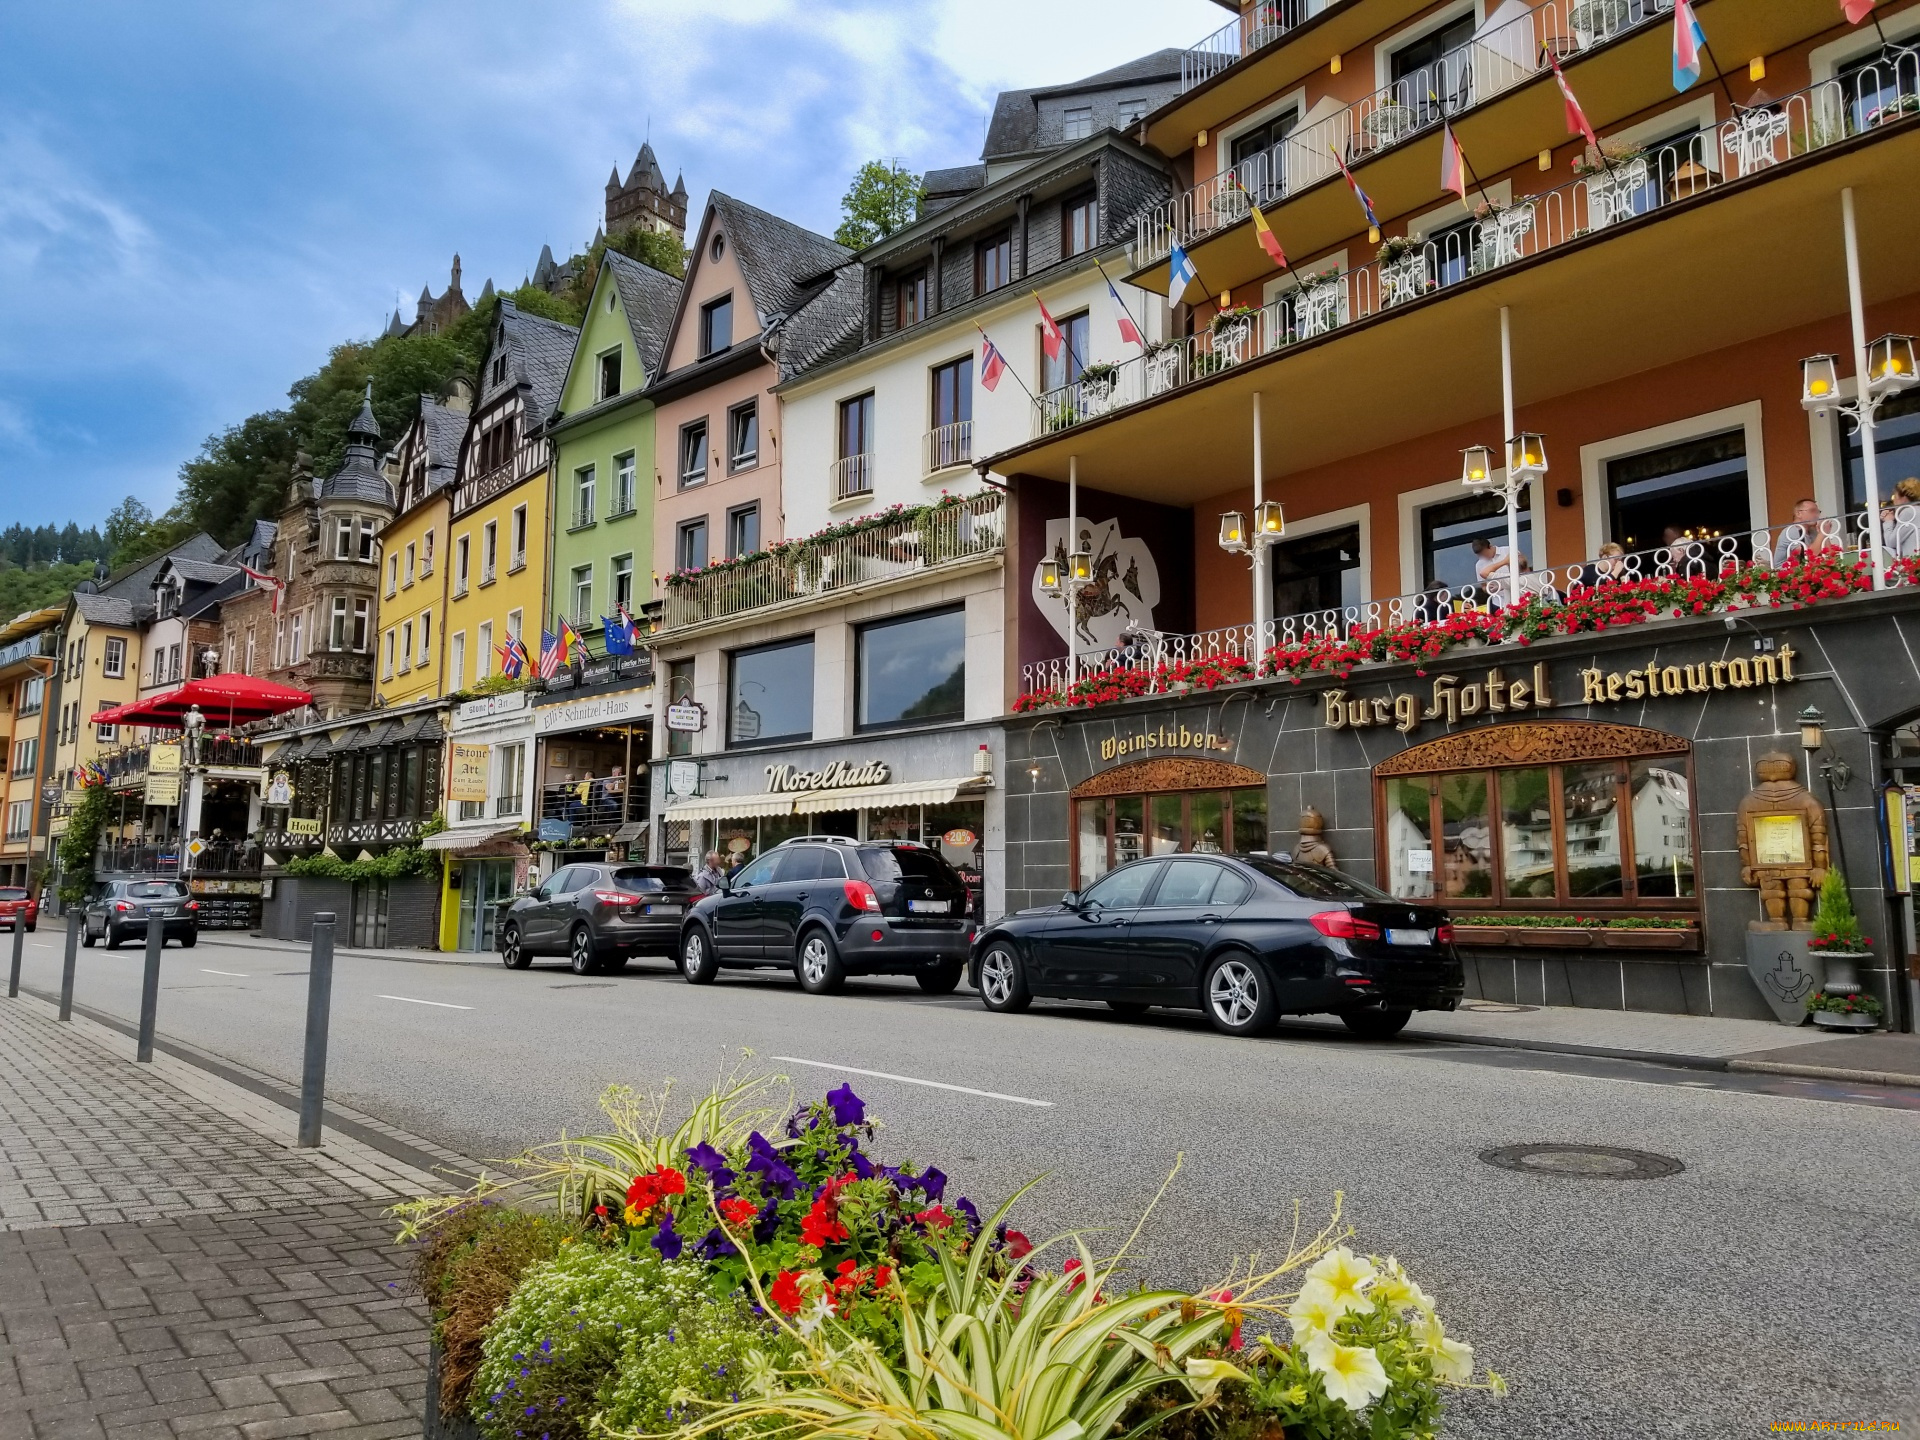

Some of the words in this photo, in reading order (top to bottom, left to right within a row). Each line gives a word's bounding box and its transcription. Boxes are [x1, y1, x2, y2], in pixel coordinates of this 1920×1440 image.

[1323, 688, 1420, 733] Burg
[1424, 661, 1556, 724] Hotel
[1581, 642, 1797, 704] Restaurant
[455, 746, 487, 758] Stone
[1101, 724, 1218, 761] Weinstuben
[461, 764, 479, 774] Art
[764, 760, 892, 793] Moselhaus
[291, 821, 319, 832] Hotel
